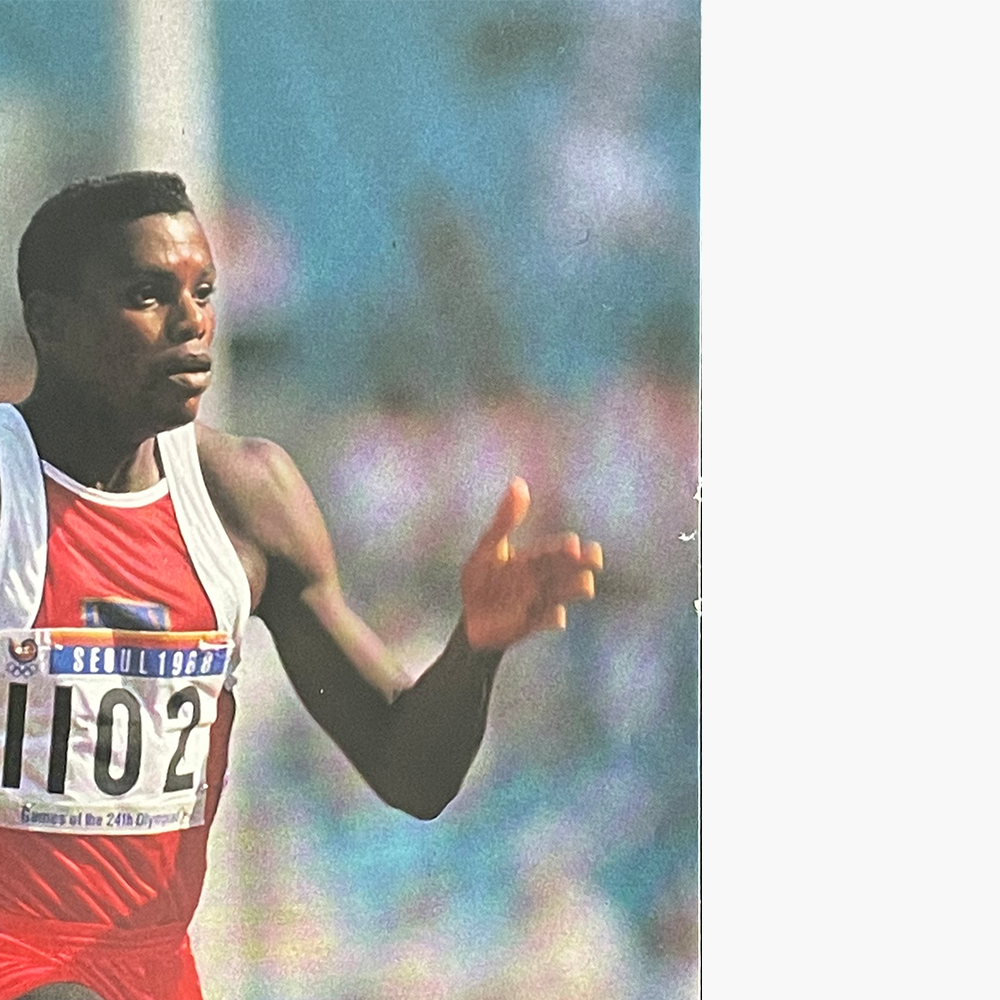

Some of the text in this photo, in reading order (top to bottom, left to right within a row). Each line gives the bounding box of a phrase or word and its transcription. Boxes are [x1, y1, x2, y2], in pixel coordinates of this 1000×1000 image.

[72, 647, 146, 675] SEOUL
[2, 682, 201, 796] 1102
[21, 805, 66, 826] Games
[106, 812, 133, 826] 24th
